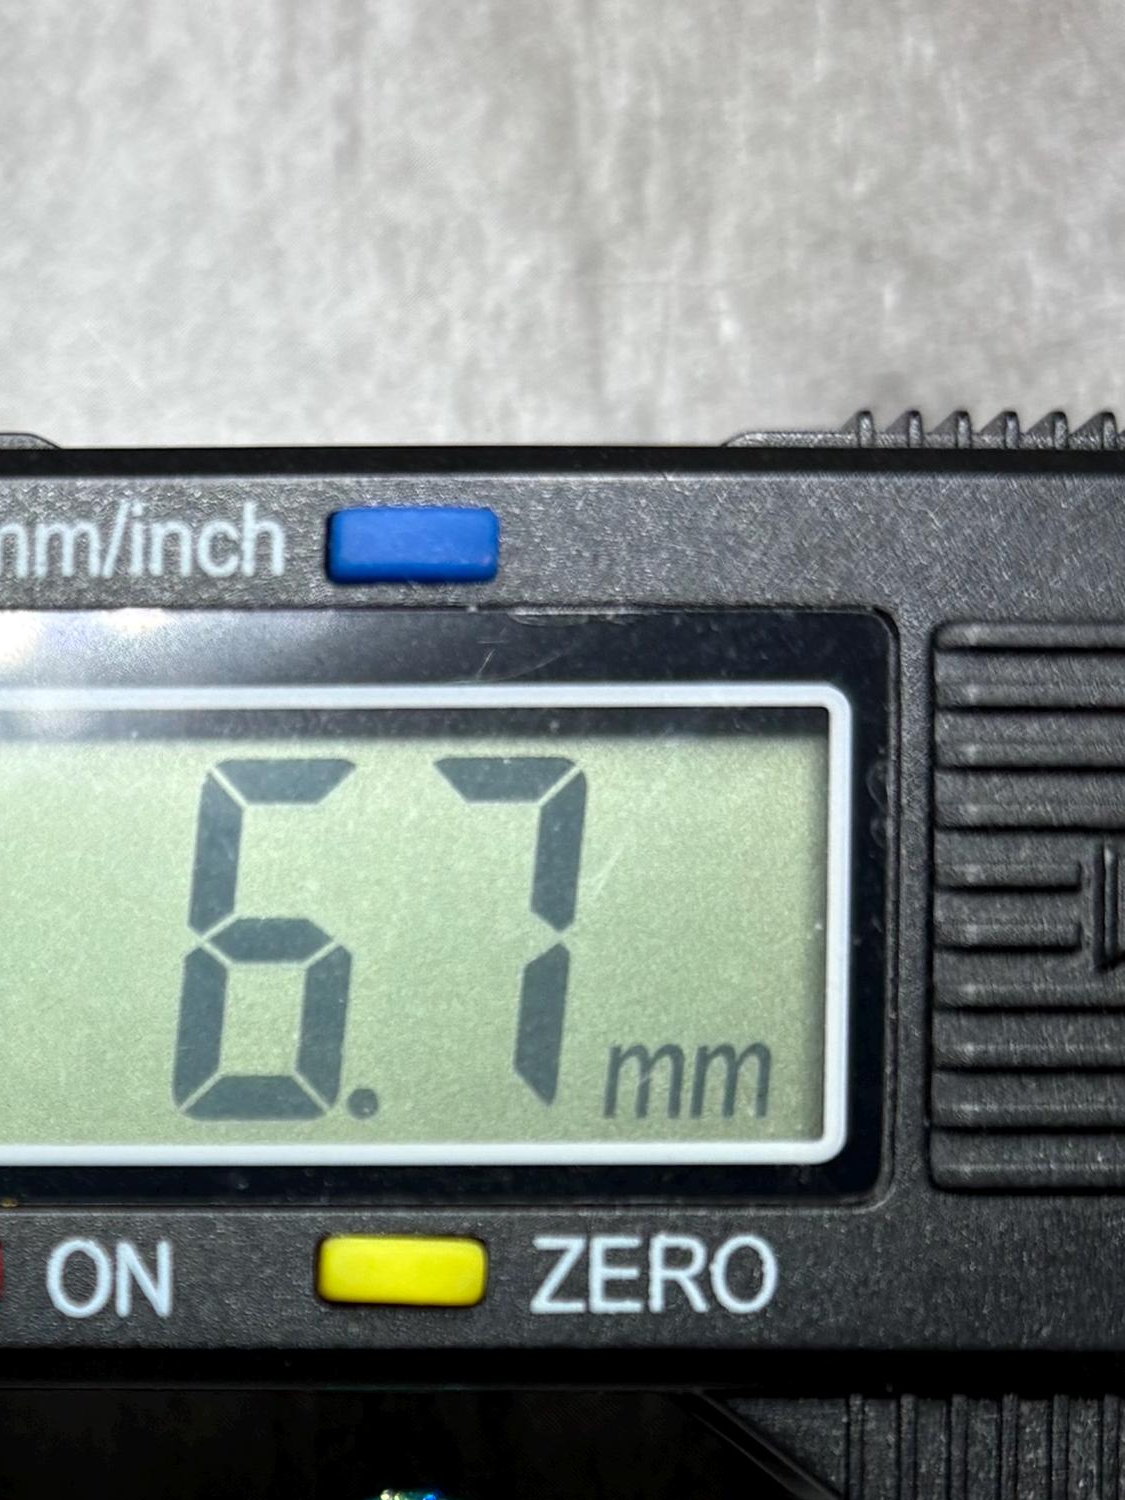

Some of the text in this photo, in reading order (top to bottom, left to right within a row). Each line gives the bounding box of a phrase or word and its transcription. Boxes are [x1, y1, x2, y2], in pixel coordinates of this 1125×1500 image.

[172, 756, 774, 1122] 6.7 mm
[45, 1237, 174, 1319] ON
[529, 1233, 778, 1315] ZERO
